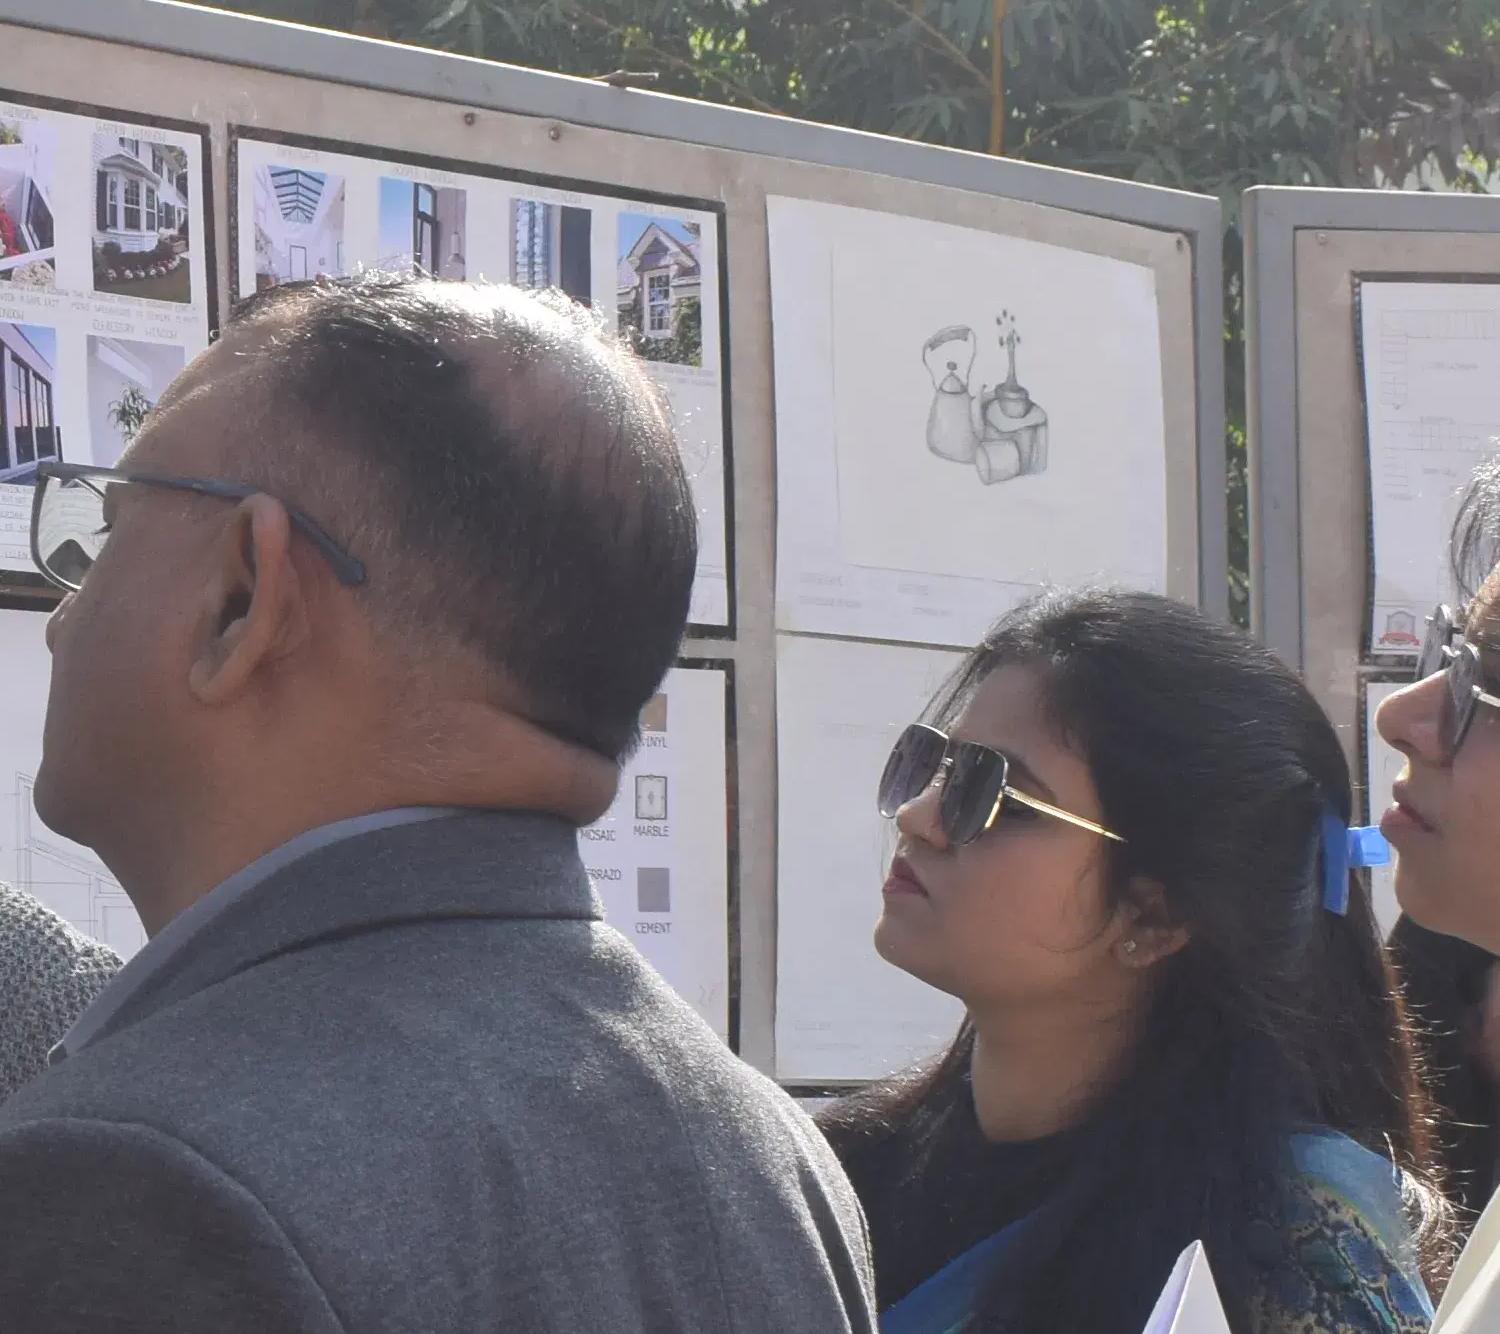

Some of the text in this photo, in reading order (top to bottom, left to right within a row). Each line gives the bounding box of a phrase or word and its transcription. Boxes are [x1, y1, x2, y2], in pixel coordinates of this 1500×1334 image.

[581, 829, 616, 841] MOSAIC
[634, 826, 669, 837] MARBLE
[635, 922, 672, 934] CEMENT
